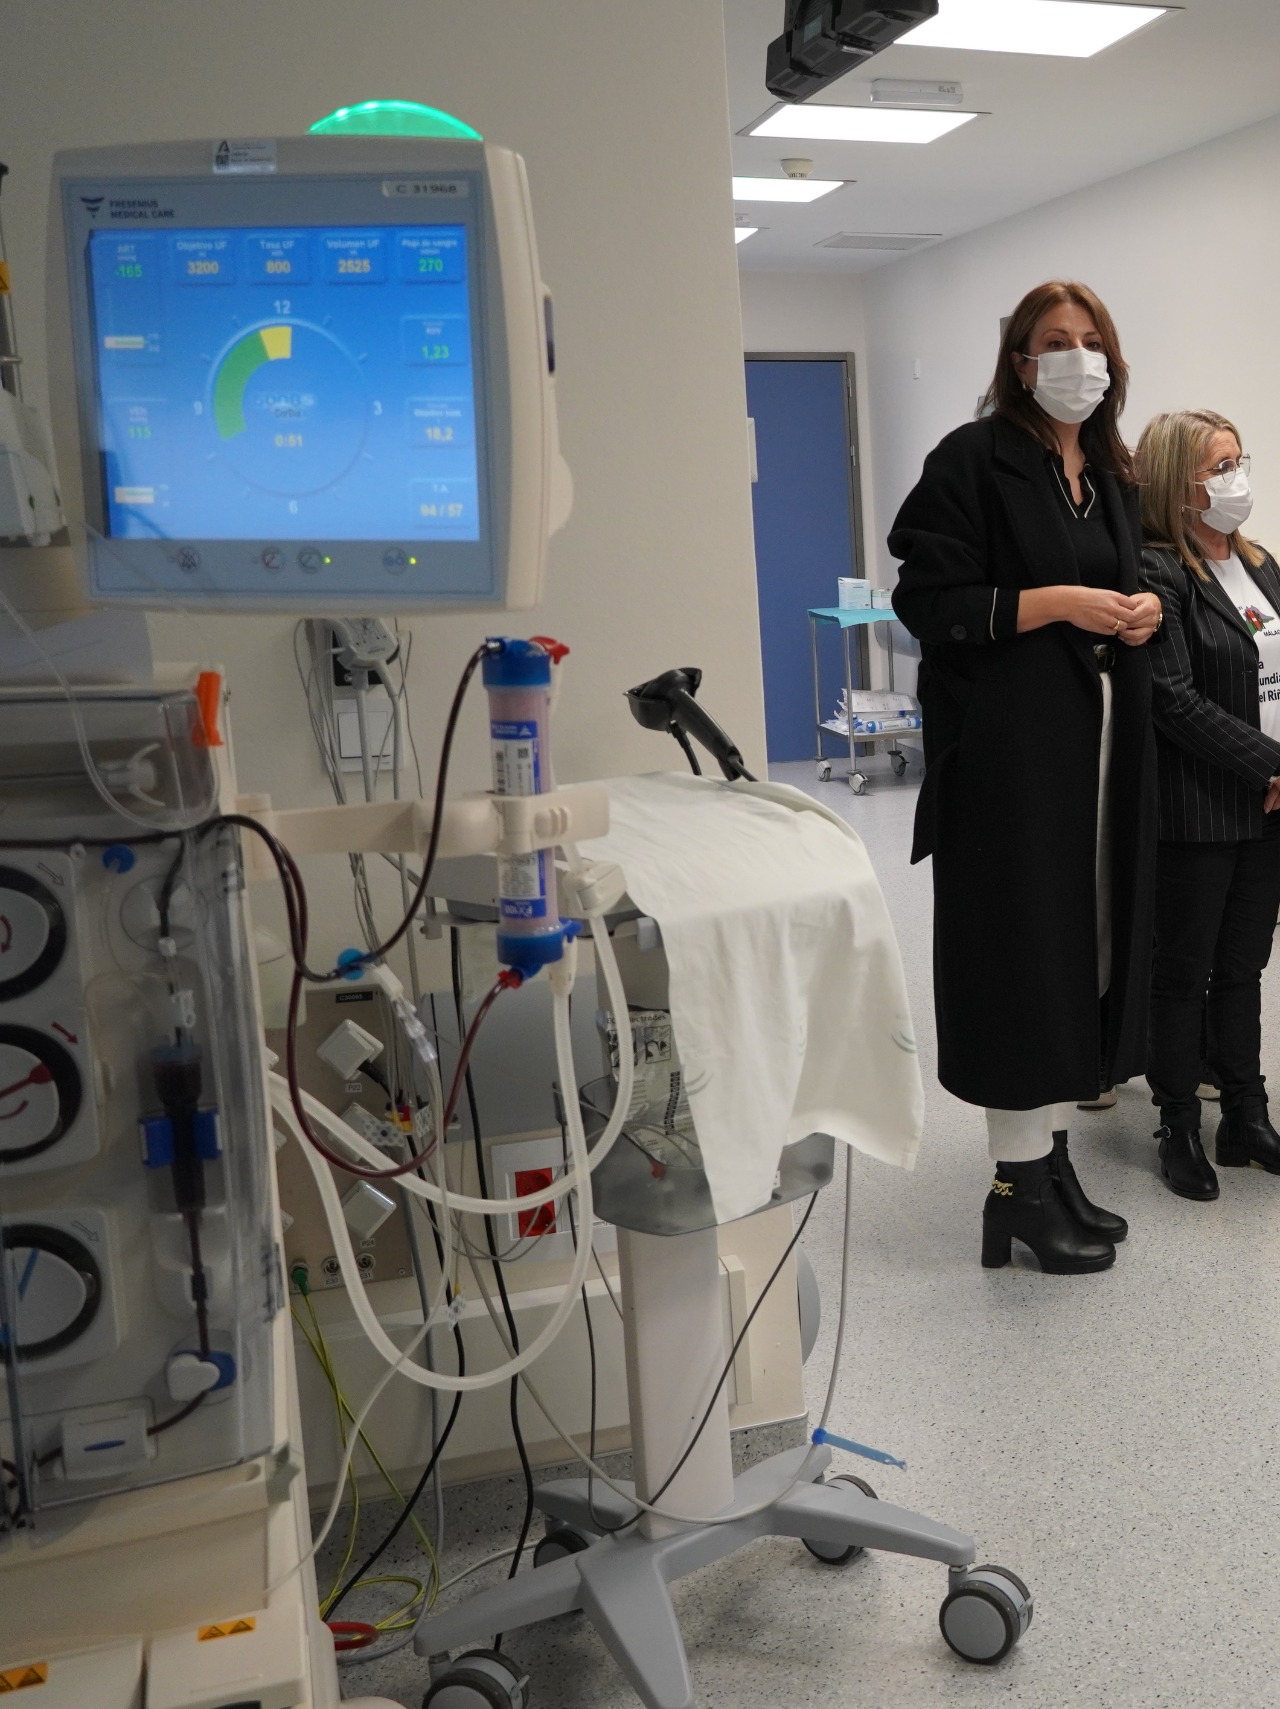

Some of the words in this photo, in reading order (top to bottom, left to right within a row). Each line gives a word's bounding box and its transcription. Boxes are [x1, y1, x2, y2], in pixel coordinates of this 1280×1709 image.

[109, 199, 159, 208] FRESENIUS
[110, 210, 149, 219] MEDICAL
[151, 209, 176, 218] CARE
[326, 239, 365, 249] Volumen
[187, 262, 220, 275] 3200
[265, 260, 291, 274] 800
[337, 259, 371, 273] 2525
[418, 259, 444, 273] 270
[273, 300, 291, 315] 12
[194, 400, 203, 416] 9
[373, 400, 383, 416] 3
[128, 426, 151, 439] 115
[289, 499, 298, 515] 6
[1258, 691, 1266, 703] el
[629, 1013, 667, 1023] ectrodes
